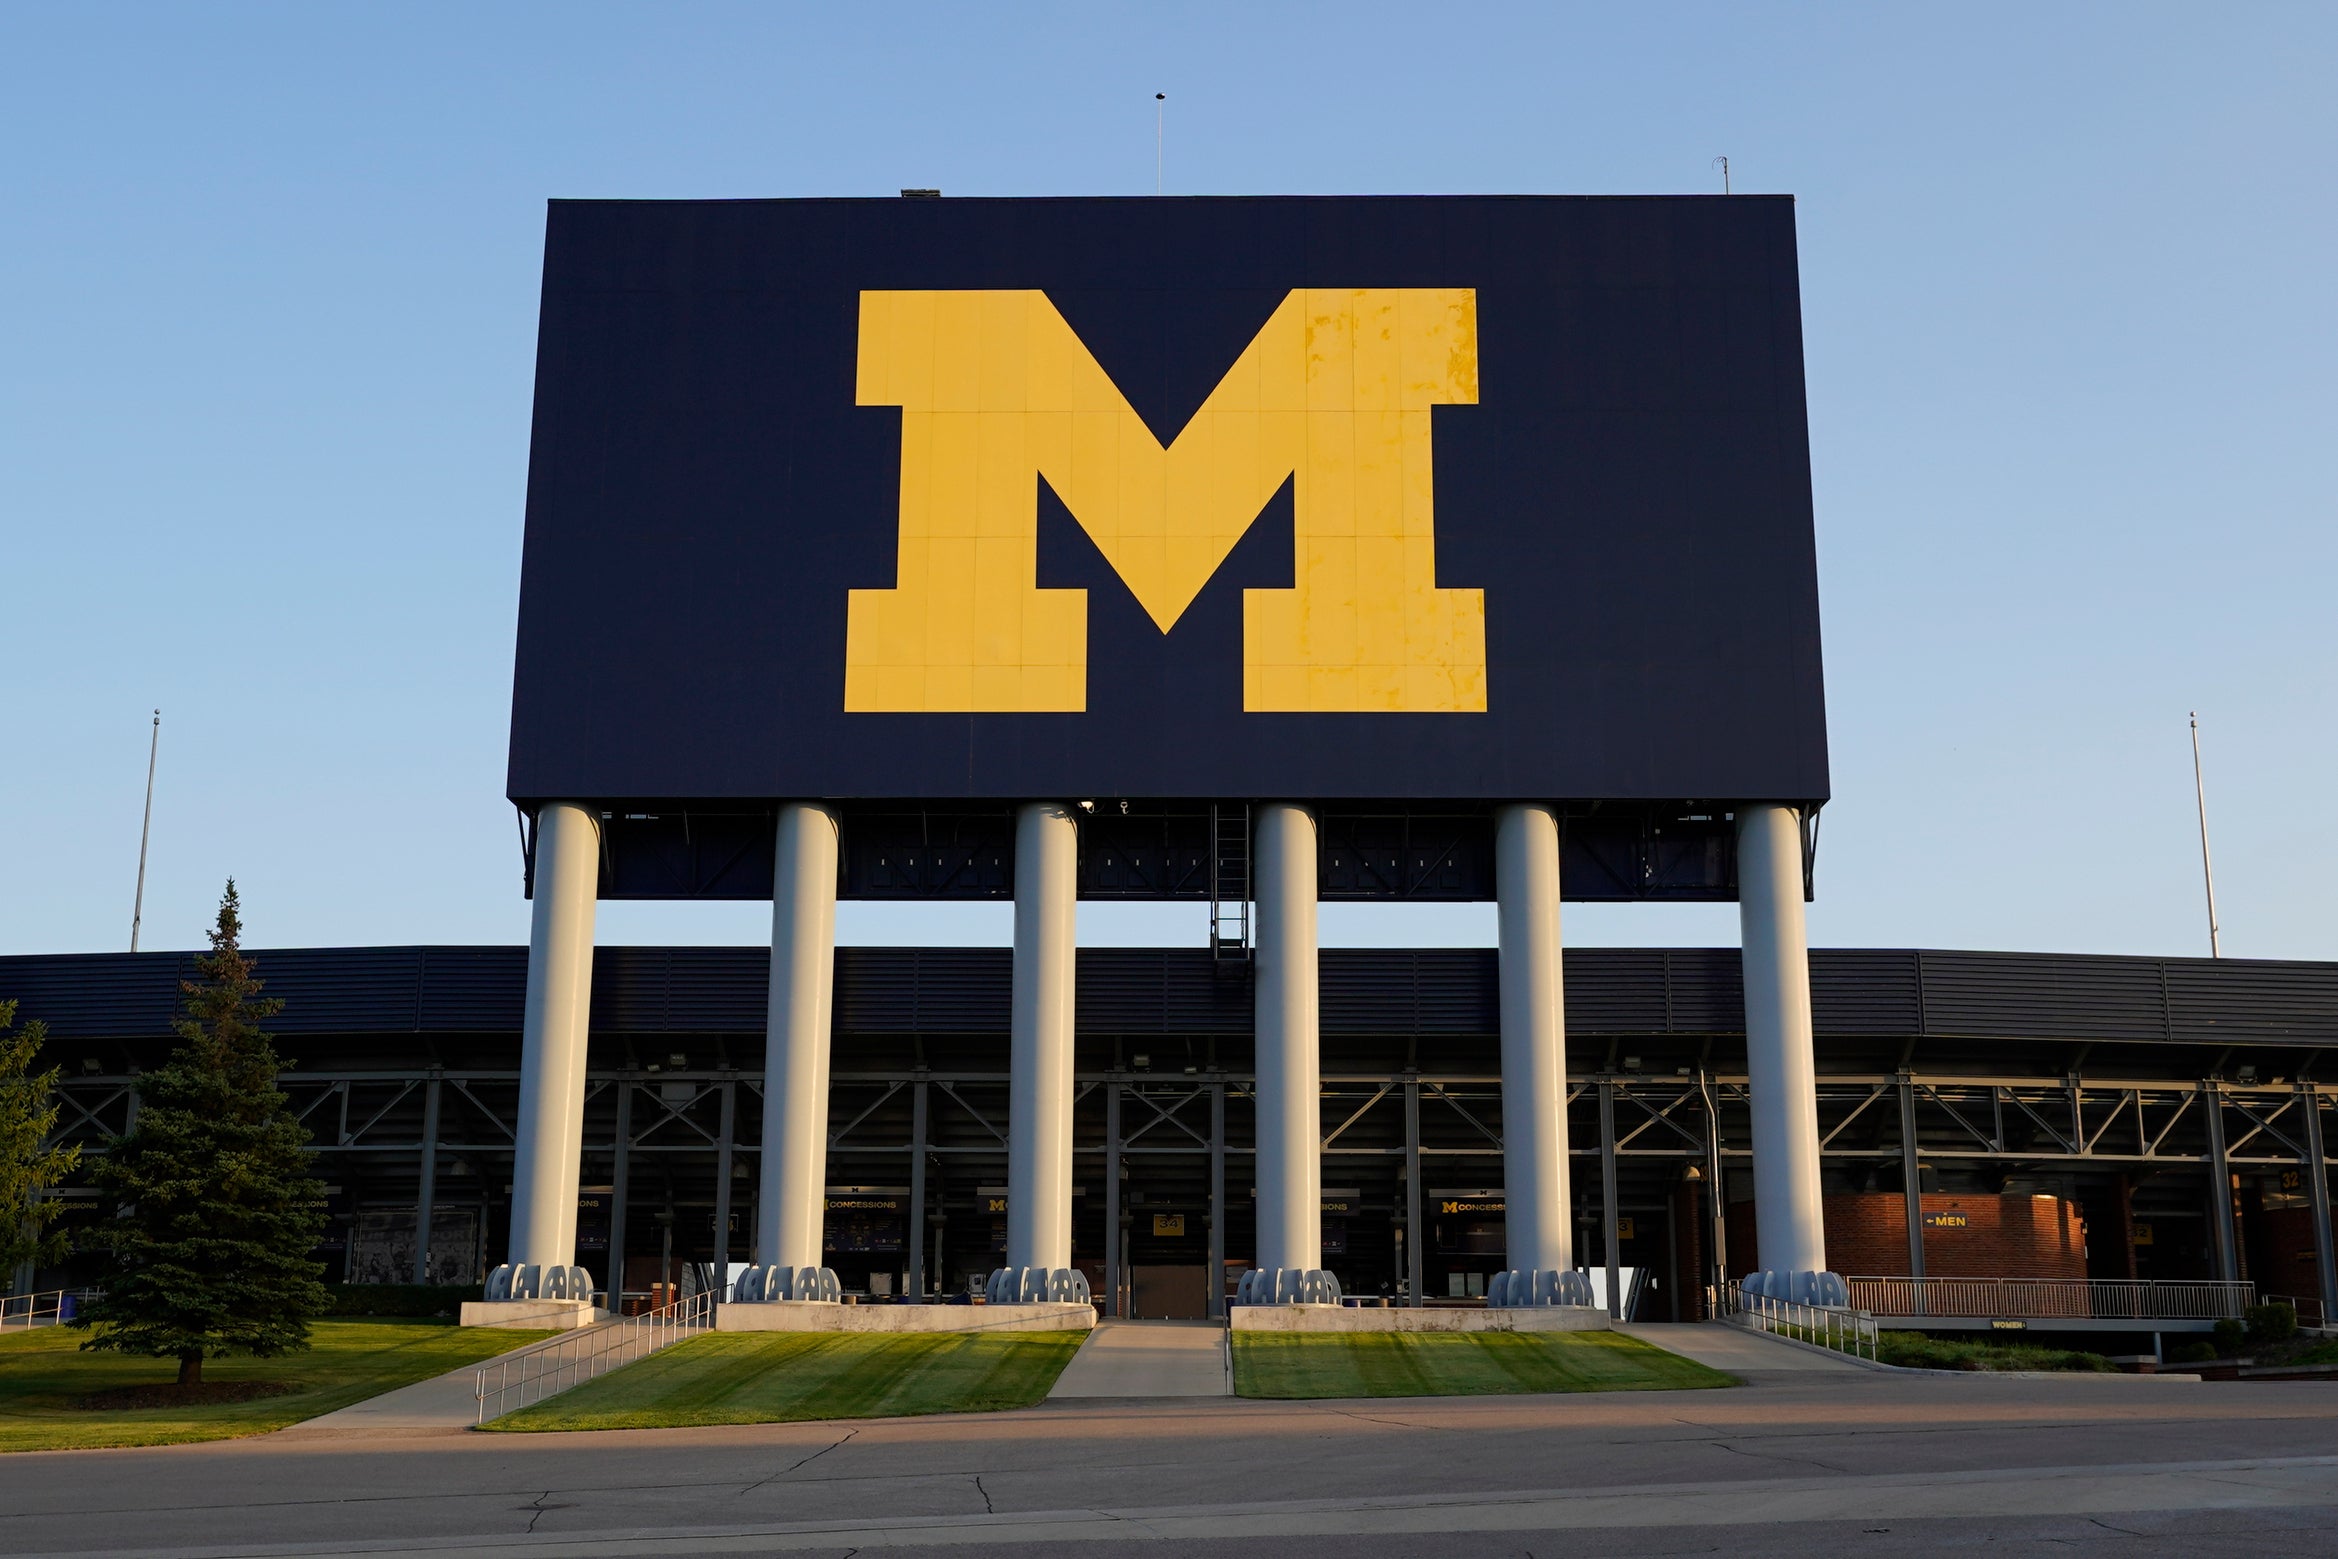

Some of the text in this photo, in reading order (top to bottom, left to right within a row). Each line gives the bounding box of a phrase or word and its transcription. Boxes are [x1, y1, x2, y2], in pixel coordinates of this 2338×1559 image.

[844, 288, 1487, 712] M
[2282, 1171, 2299, 1188] 32
[829, 1201, 897, 1209] CONCESSIONS
[989, 1199, 1005, 1212] M
[1441, 1201, 1458, 1214] M
[1159, 1219, 1177, 1229] 34
[1935, 1216, 1966, 1227] MEN
[1991, 1321, 2023, 1329] WOMEN
